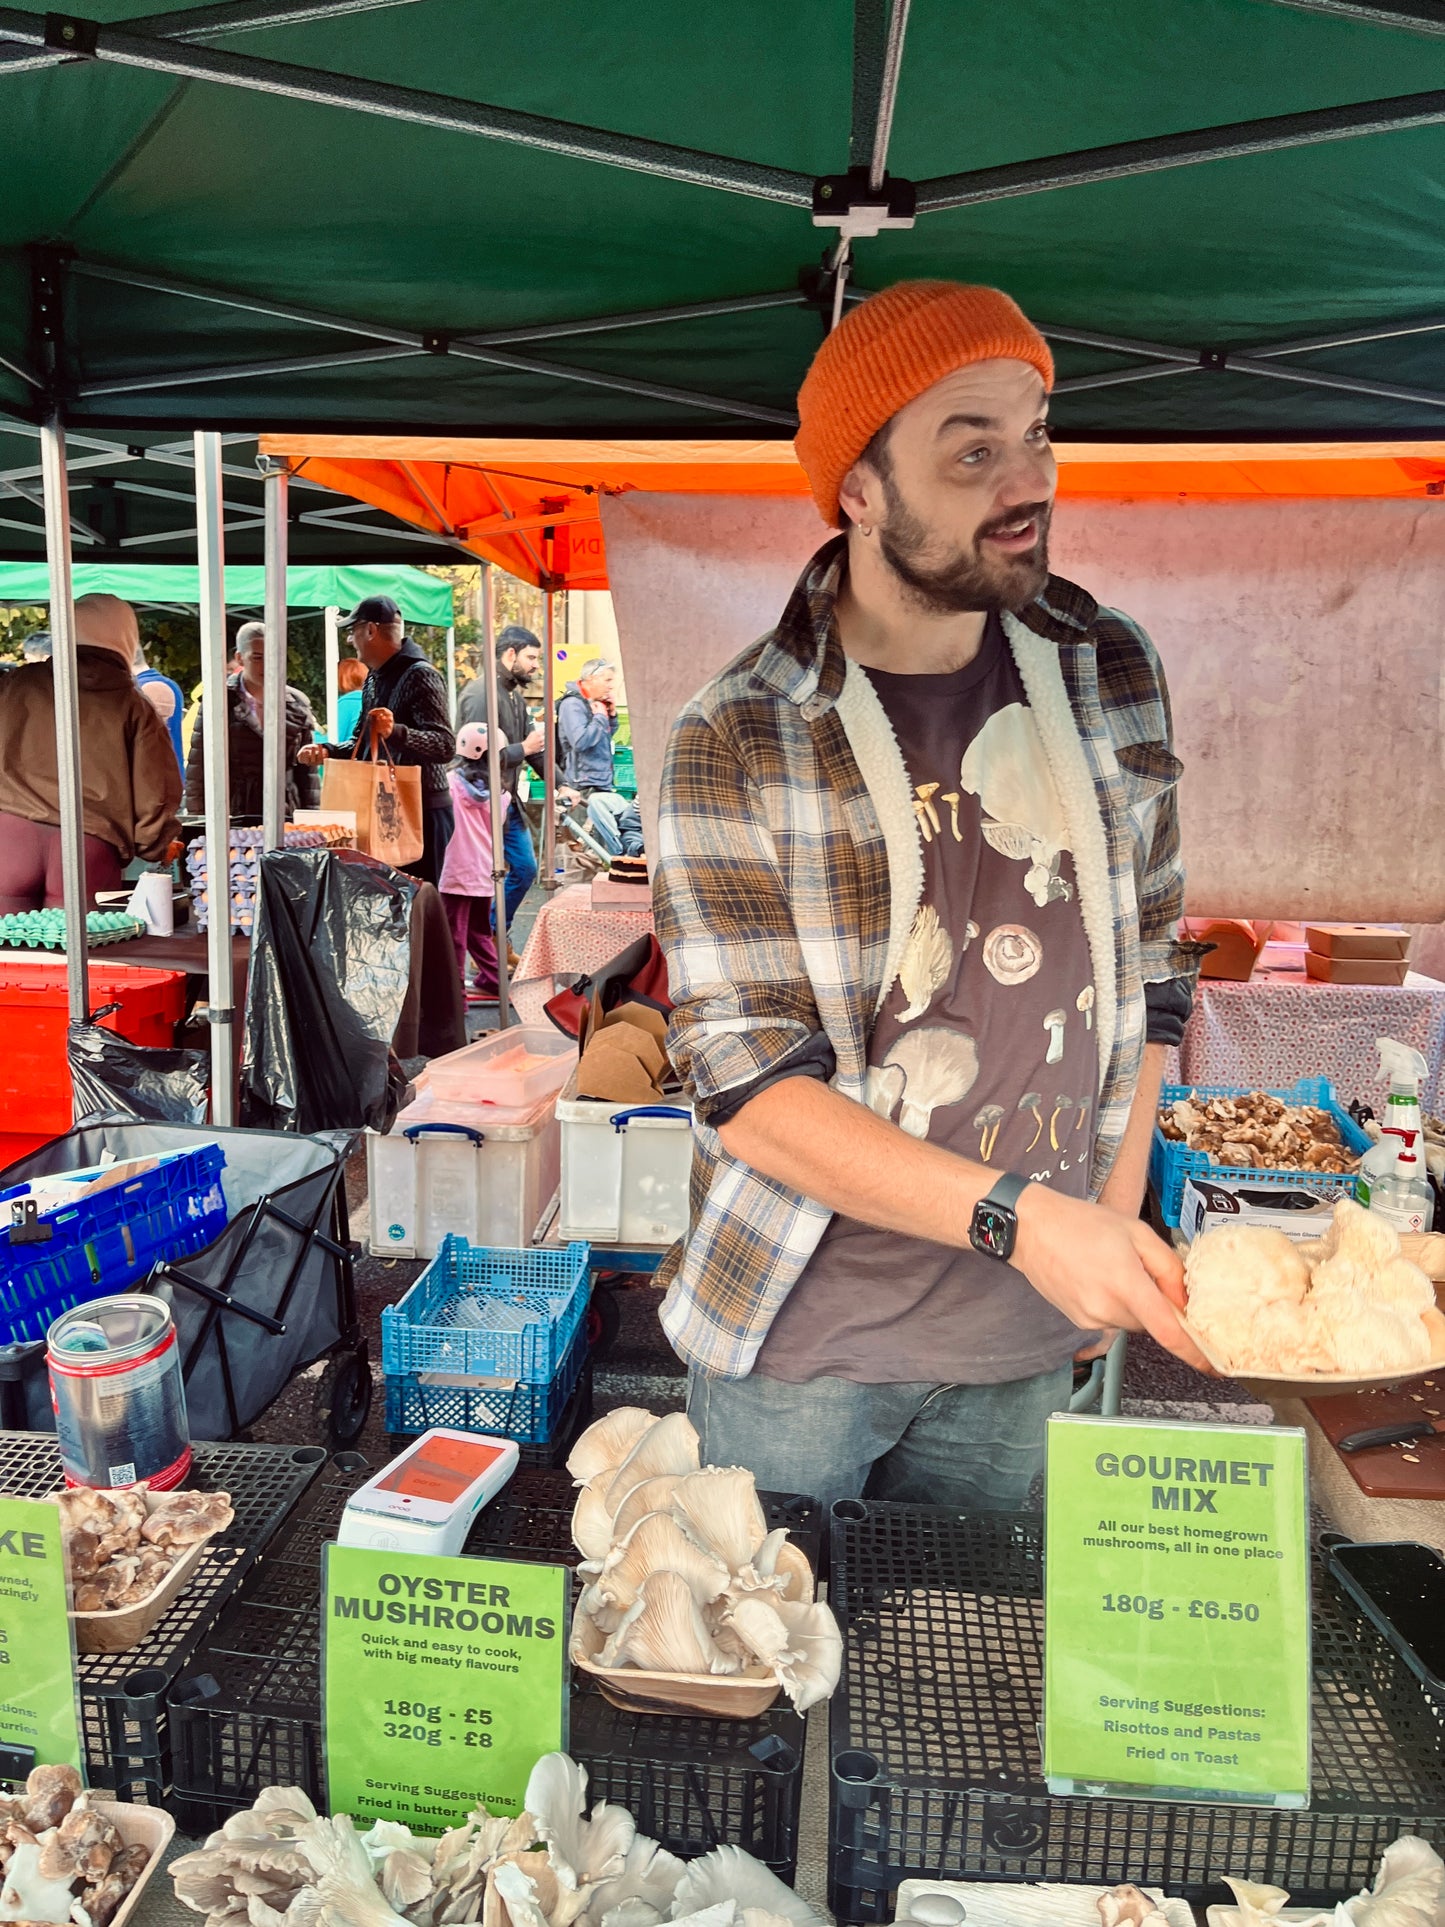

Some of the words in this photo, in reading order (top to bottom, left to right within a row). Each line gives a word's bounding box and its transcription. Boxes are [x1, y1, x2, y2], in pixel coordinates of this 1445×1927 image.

[1095, 1453, 1274, 1486] GOURMET
[1152, 1486, 1218, 1513] MIX
[1098, 1520, 1116, 1531] All
[1121, 1524, 1144, 1533] our
[1148, 1523, 1180, 1536] best
[1184, 1525, 1268, 1542] homegrown
[1083, 1537, 1170, 1554] mushrooms,
[1174, 1541, 1191, 1553] all
[1196, 1542, 1209, 1554] in
[1213, 1546, 1240, 1556] one
[1244, 1546, 1283, 1559] place
[378, 1574, 510, 1608] OYSTER
[333, 1596, 556, 1640] MUSHROOMS
[1102, 1593, 1164, 1620] 180g
[1188, 1600, 1259, 1622] £6.50
[361, 1633, 399, 1646] Quick
[403, 1639, 427, 1649] and
[432, 1643, 463, 1655] easy
[467, 1644, 481, 1655] to
[485, 1648, 521, 1661] cook,
[364, 1648, 392, 1659] with
[397, 1651, 417, 1664] big
[421, 1656, 462, 1669] meaty
[466, 1658, 519, 1673] flavours
[384, 1700, 441, 1724] 180g
[464, 1708, 492, 1725] £5
[1099, 1695, 1159, 1714] Serving
[1164, 1700, 1265, 1718] Suggestions:
[384, 1722, 442, 1746] 320g
[464, 1731, 492, 1748] £8
[1104, 1720, 1169, 1736] Risottos
[1174, 1726, 1202, 1738] and
[1208, 1728, 1261, 1742] Pastas
[1126, 1746, 1165, 1760] Fried
[1170, 1752, 1189, 1762] on
[1194, 1751, 1239, 1765] Toast
[366, 1779, 420, 1796] Serving
[424, 1786, 516, 1806] Suggestions:
[357, 1796, 393, 1810] Fried
[397, 1800, 411, 1812] in
[414, 1803, 458, 1817] butter
